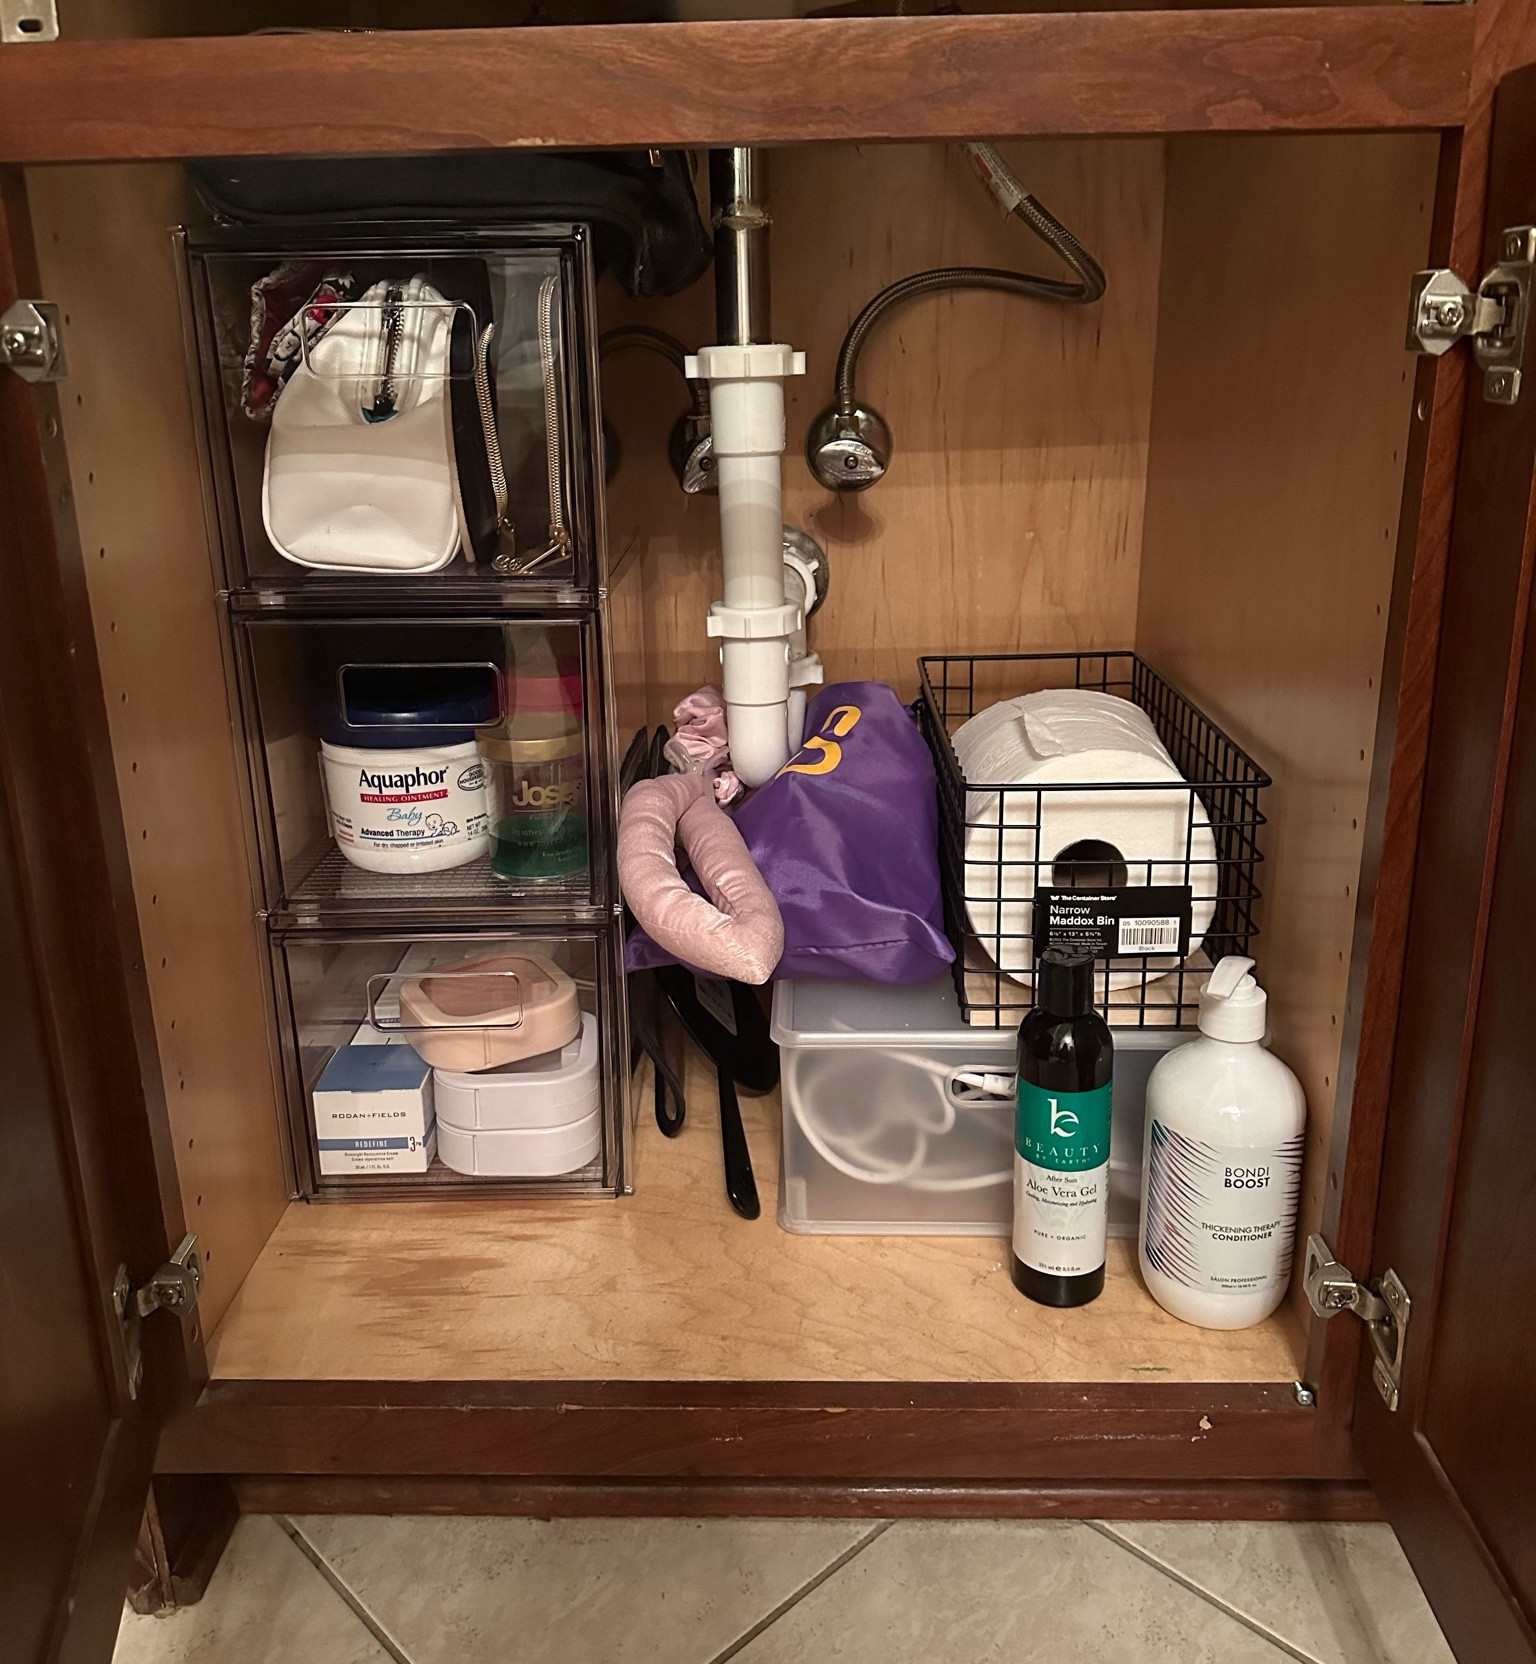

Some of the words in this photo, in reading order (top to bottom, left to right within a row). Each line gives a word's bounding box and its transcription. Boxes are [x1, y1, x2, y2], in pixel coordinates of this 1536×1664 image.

[359, 766, 448, 794] Aquaphor
[400, 792, 444, 802] OINTMENT
[387, 807, 422, 826] Baby
[361, 828, 394, 837] Advanced
[396, 828, 425, 837] Therapy
[1050, 905, 1090, 914] Narrow
[1050, 916, 1094, 925] Maddox
[1097, 916, 1115, 925] Bin
[355, 1140, 388, 1148] REDEFINE
[410, 1136, 416, 1152] 3
[1025, 1137, 1099, 1157] BEAUTY
[1225, 1167, 1270, 1178] BONDI
[1046, 1175, 1063, 1183] After
[1225, 1177, 1270, 1188] BOOST
[1027, 1179, 1048, 1194] Aloe
[1051, 1186, 1077, 1197] Vera
[1081, 1184, 1097, 1196] Gel
[1201, 1222, 1252, 1234] THICKENING
[1253, 1220, 1281, 1233] THERAPY
[1034, 1229, 1047, 1238] PURE
[1212, 1232, 1272, 1241] CONDITIONER
[1230, 1275, 1267, 1283] PROFESSIONAL
